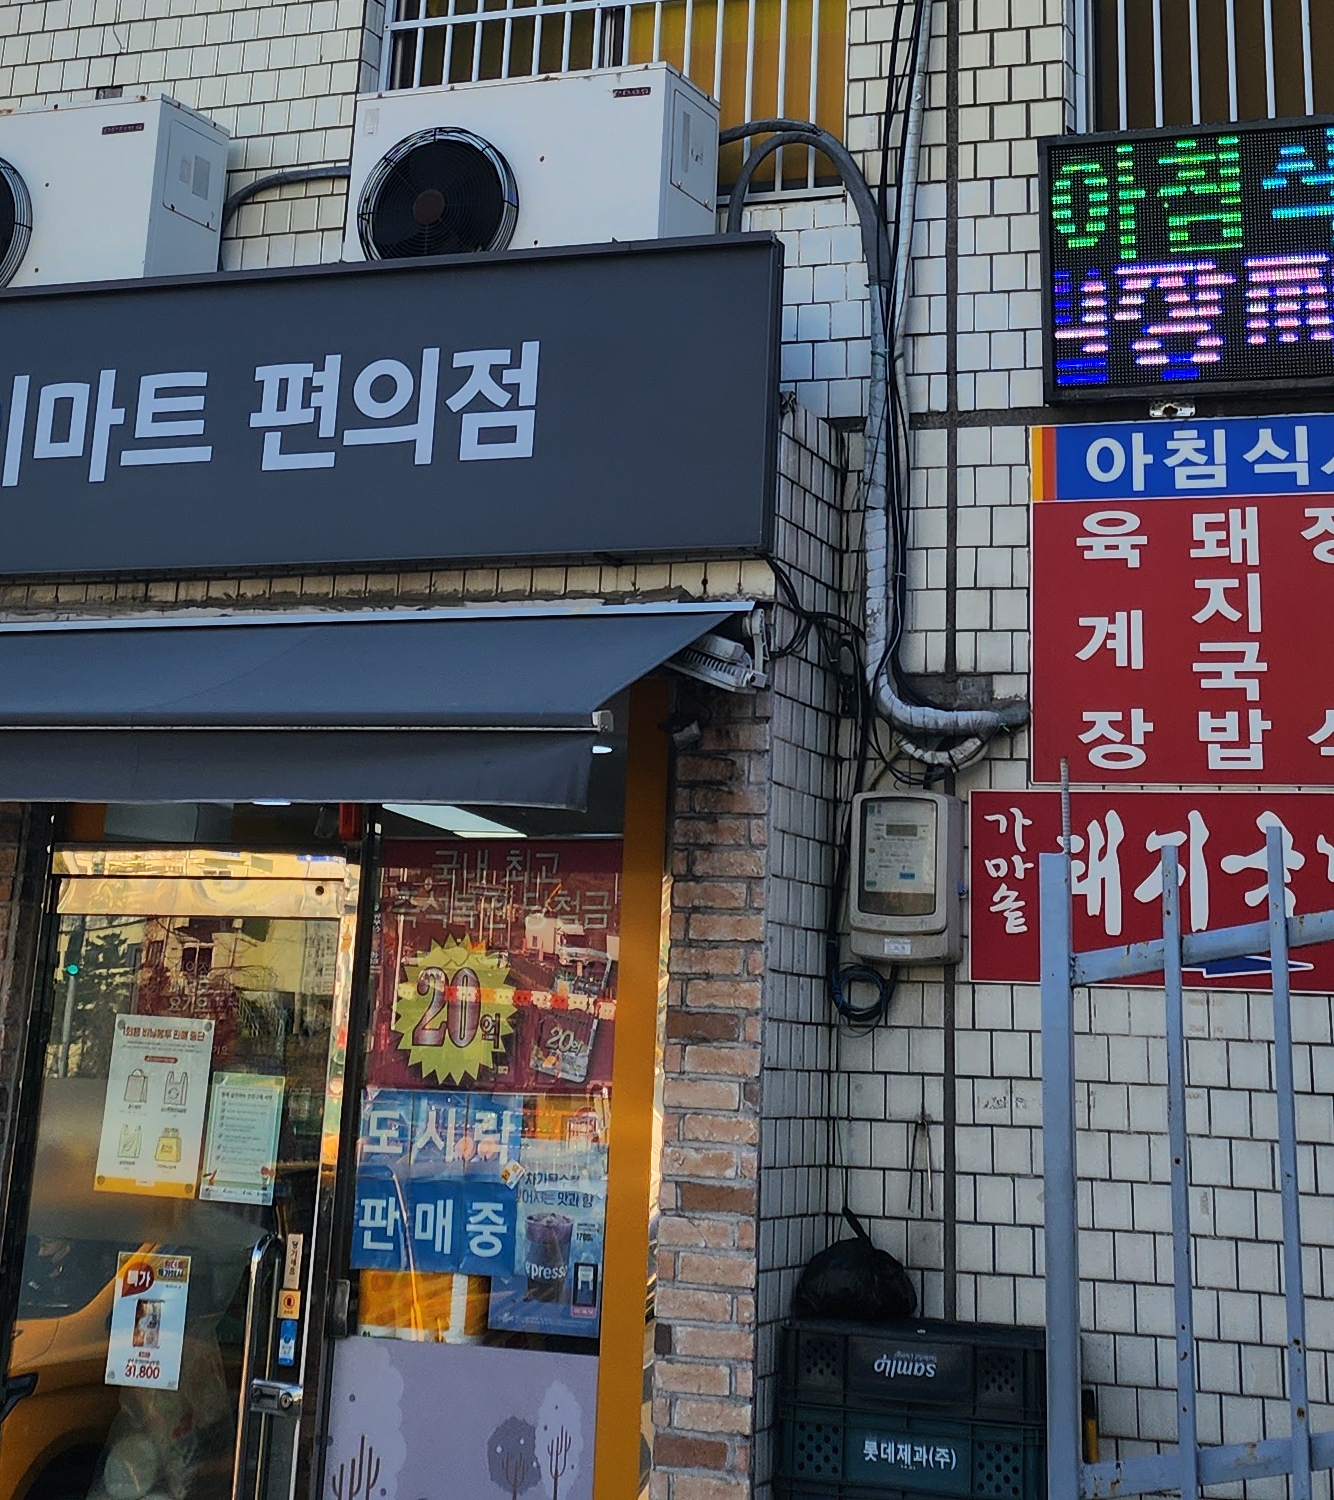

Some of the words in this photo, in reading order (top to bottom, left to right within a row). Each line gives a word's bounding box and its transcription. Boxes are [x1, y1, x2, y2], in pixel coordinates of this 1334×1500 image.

[248, 339, 542, 472] 편의점
[1075, 509, 1155, 771] 육계장
[1189, 505, 1273, 772] 돼지국밥
[983, 806, 1036, 935] 가마솥
[364, 1107, 516, 1165] 도시락
[358, 1196, 508, 1258] 판매중
[863, 1439, 957, 1471] 롯데제과(주)
